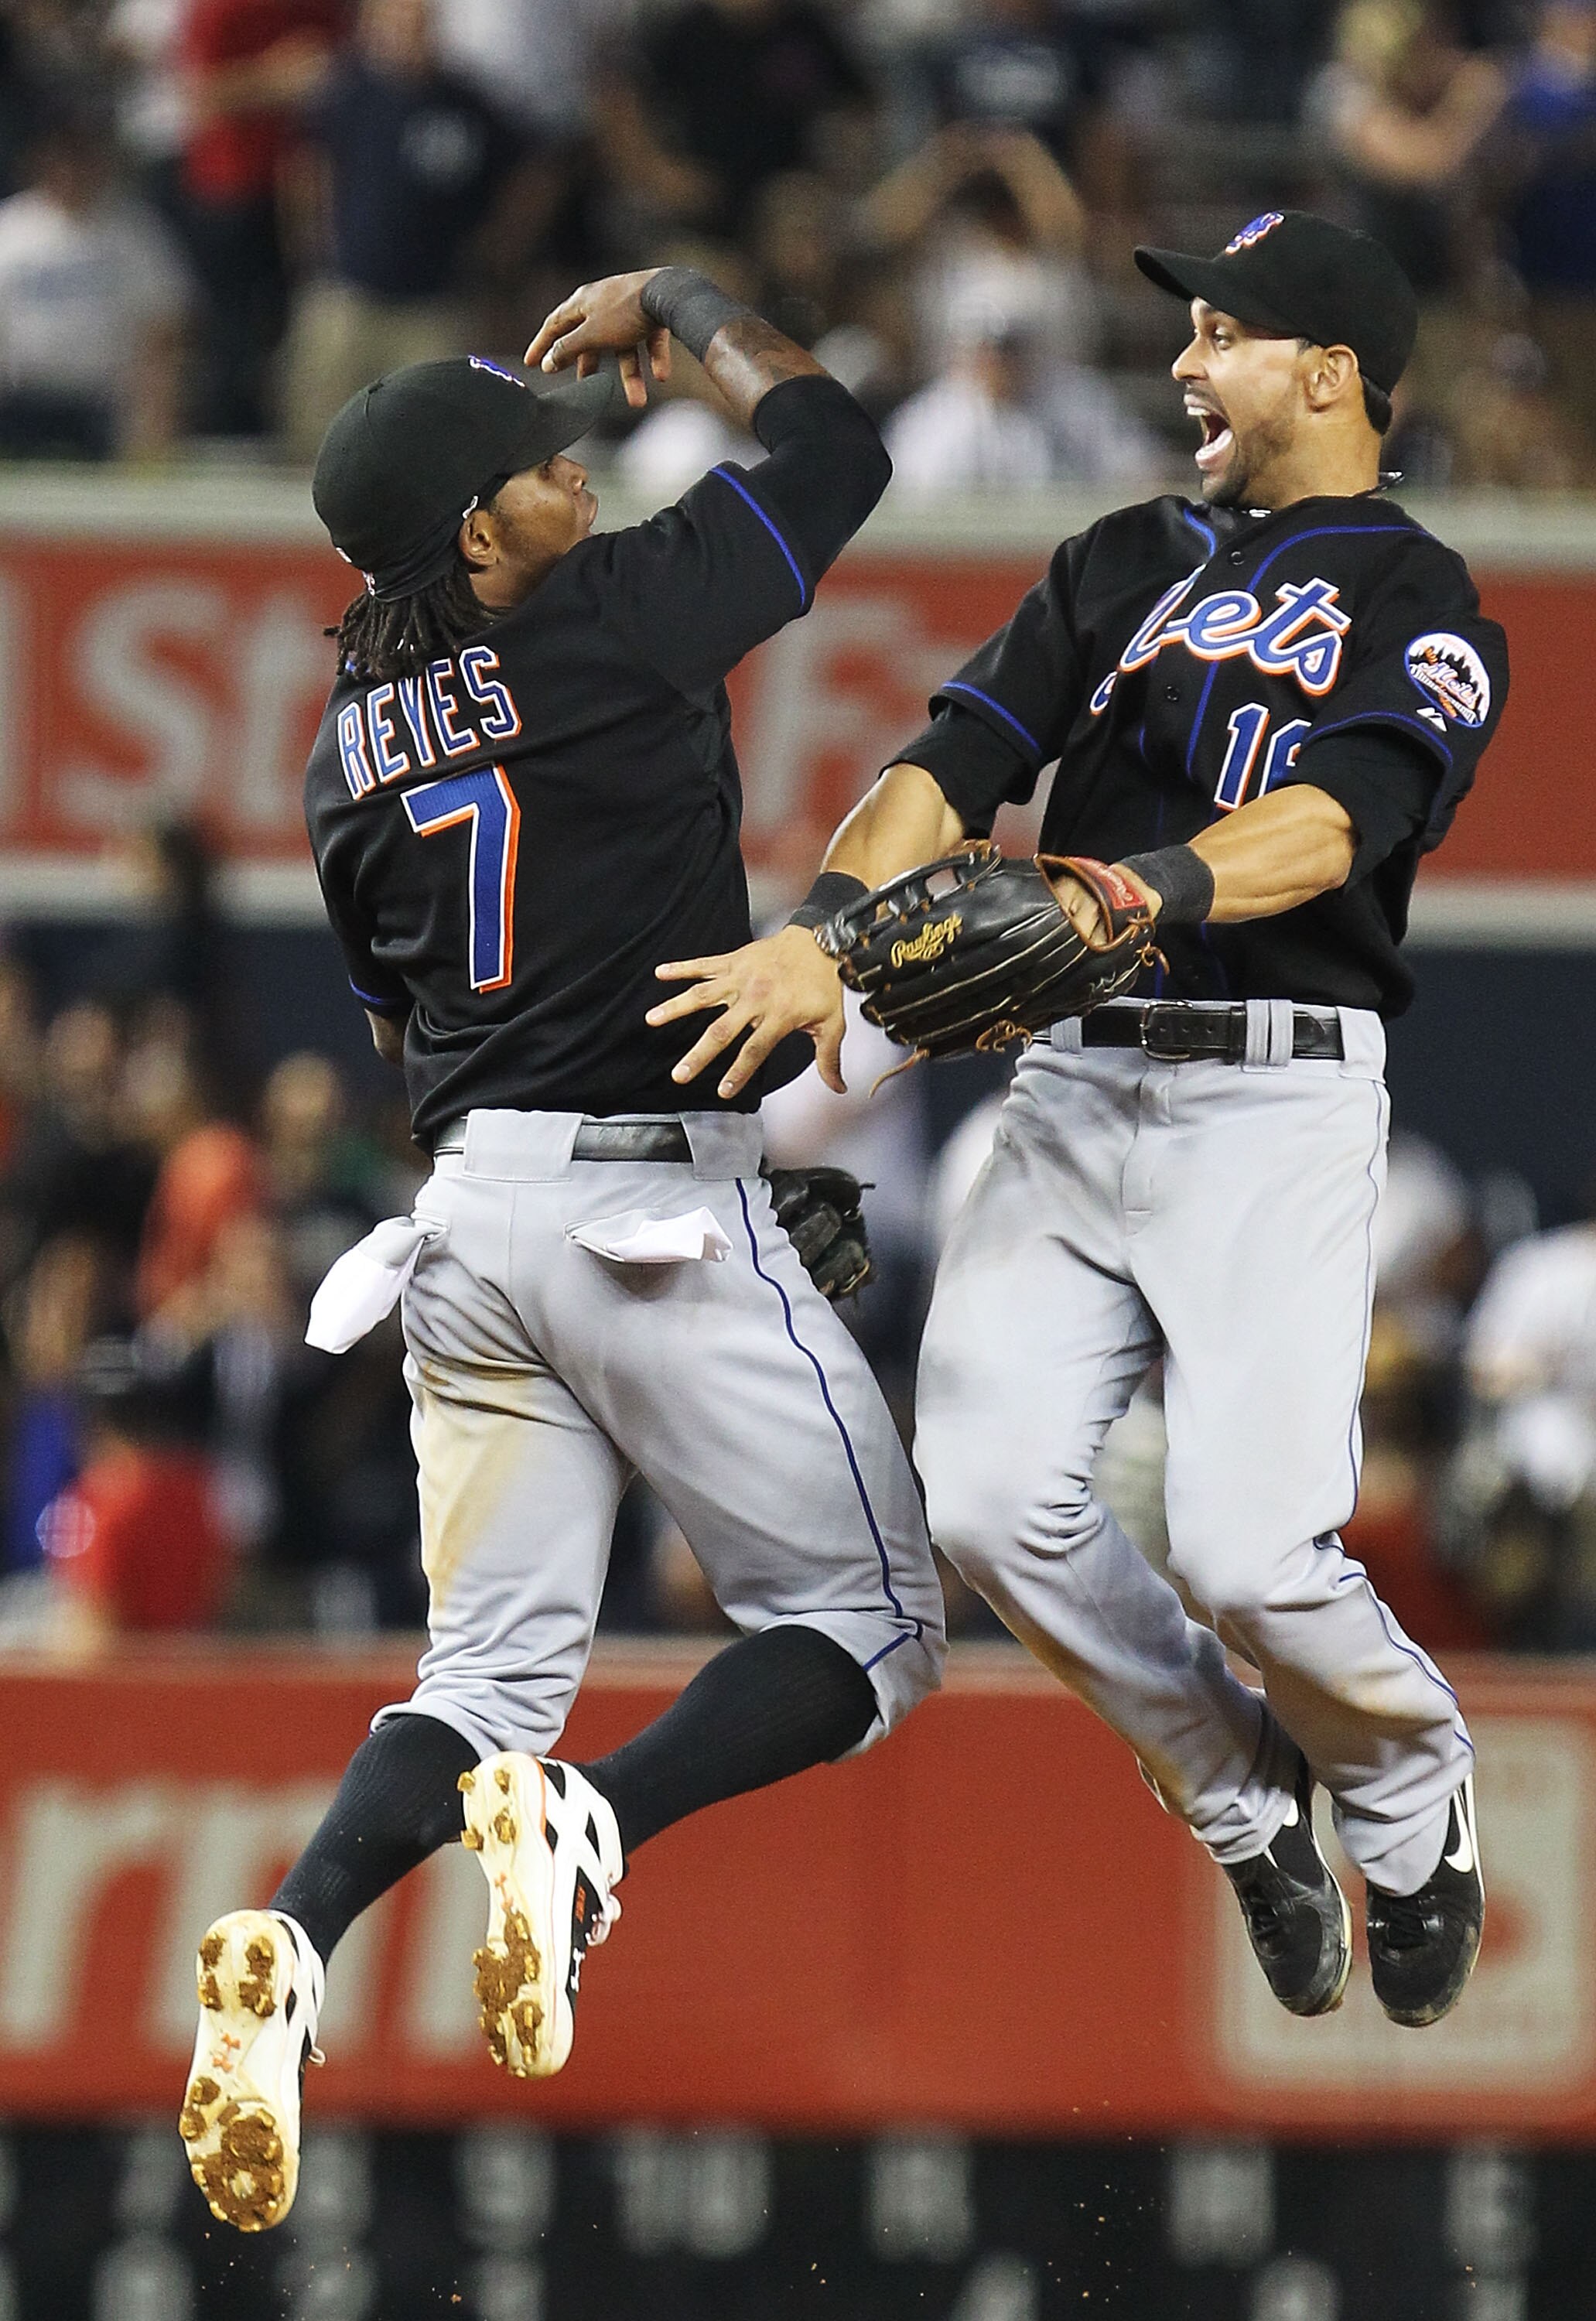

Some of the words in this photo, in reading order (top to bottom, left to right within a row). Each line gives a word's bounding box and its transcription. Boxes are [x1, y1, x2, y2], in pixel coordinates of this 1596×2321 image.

[337, 645, 521, 801] REYES
[400, 761, 521, 993] 7
[890, 911, 963, 969] Rawlings
